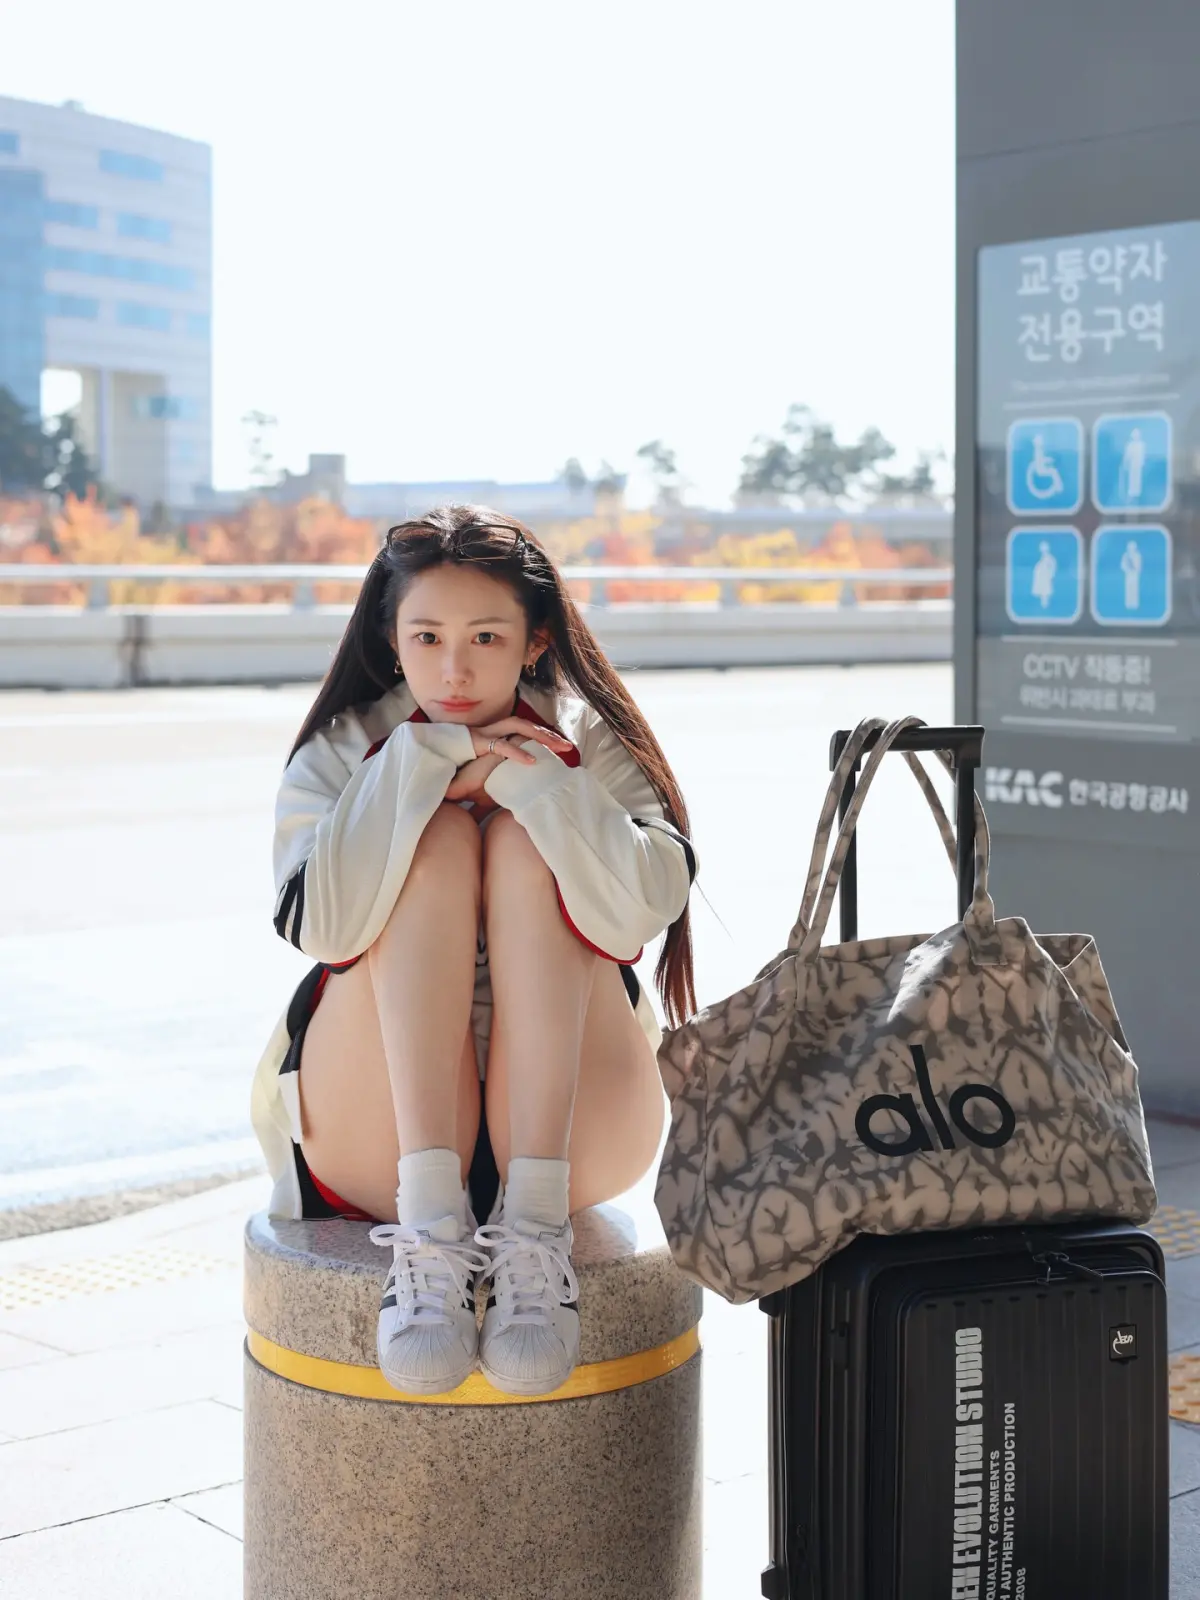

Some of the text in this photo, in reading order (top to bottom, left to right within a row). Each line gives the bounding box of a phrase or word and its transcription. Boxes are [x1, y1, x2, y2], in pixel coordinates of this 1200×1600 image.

[1016, 239, 1168, 303] 교통약자
[1017, 301, 1164, 363] 전용구역
[1023, 653, 1080, 680] CCTV
[984, 766, 1064, 808] KAC
[855, 1044, 1016, 1157] alo
[951, 1326, 984, 1600] EN EVOLUTION STUDIO
[988, 1449, 1001, 1535] GARMENTS
[1004, 1402, 1016, 1503] PRODUCTION
[1000, 1506, 1016, 1591] AUTHENTIC
